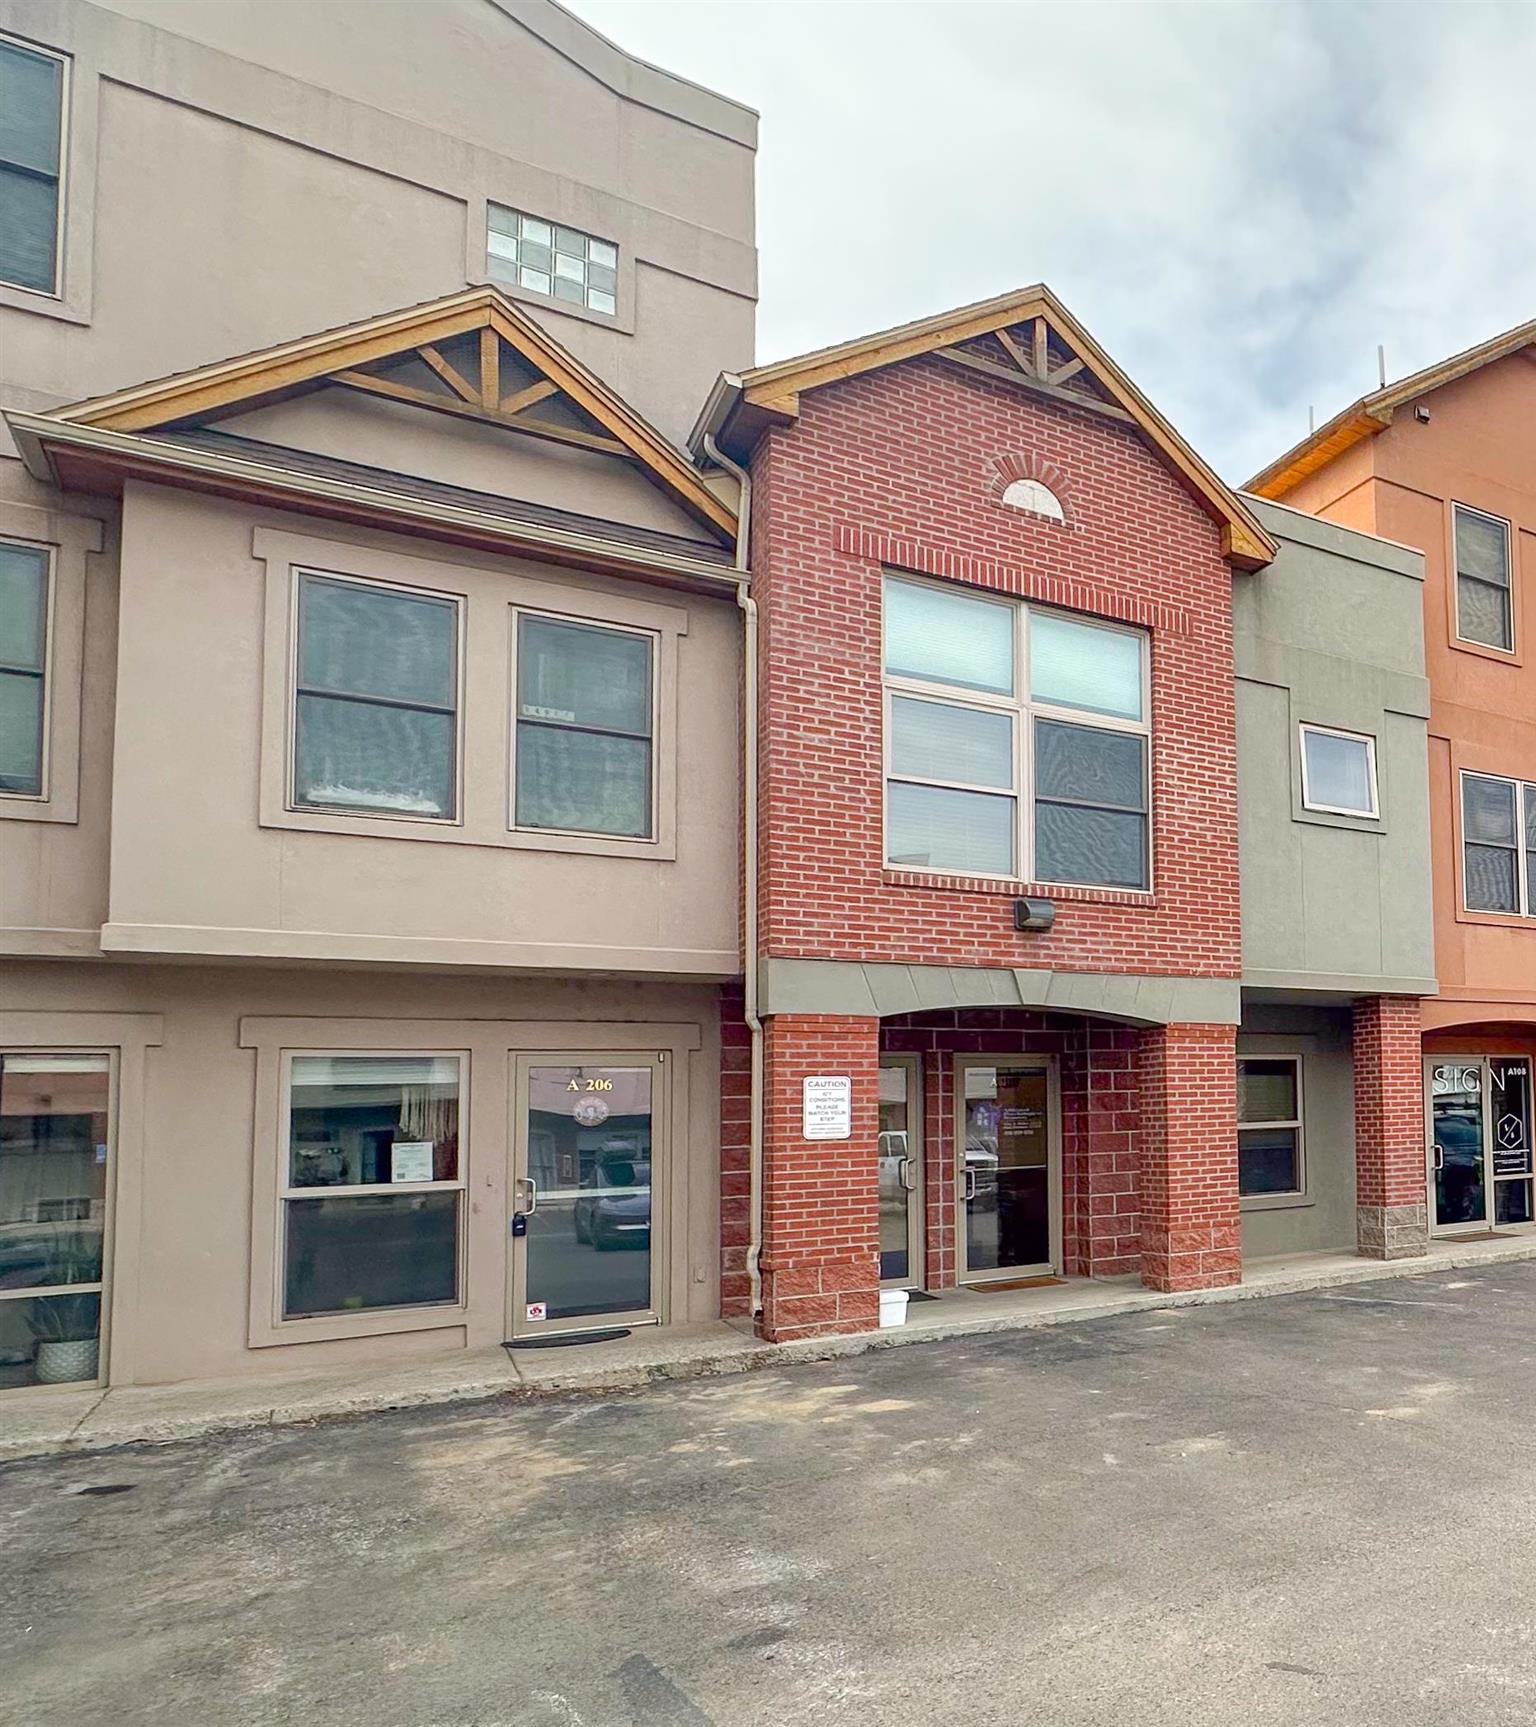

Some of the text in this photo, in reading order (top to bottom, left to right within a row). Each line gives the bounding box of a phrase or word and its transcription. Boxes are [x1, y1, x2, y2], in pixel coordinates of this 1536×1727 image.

[566, 1079, 613, 1091] A 206
[1433, 1067, 1505, 1092] SIGN
